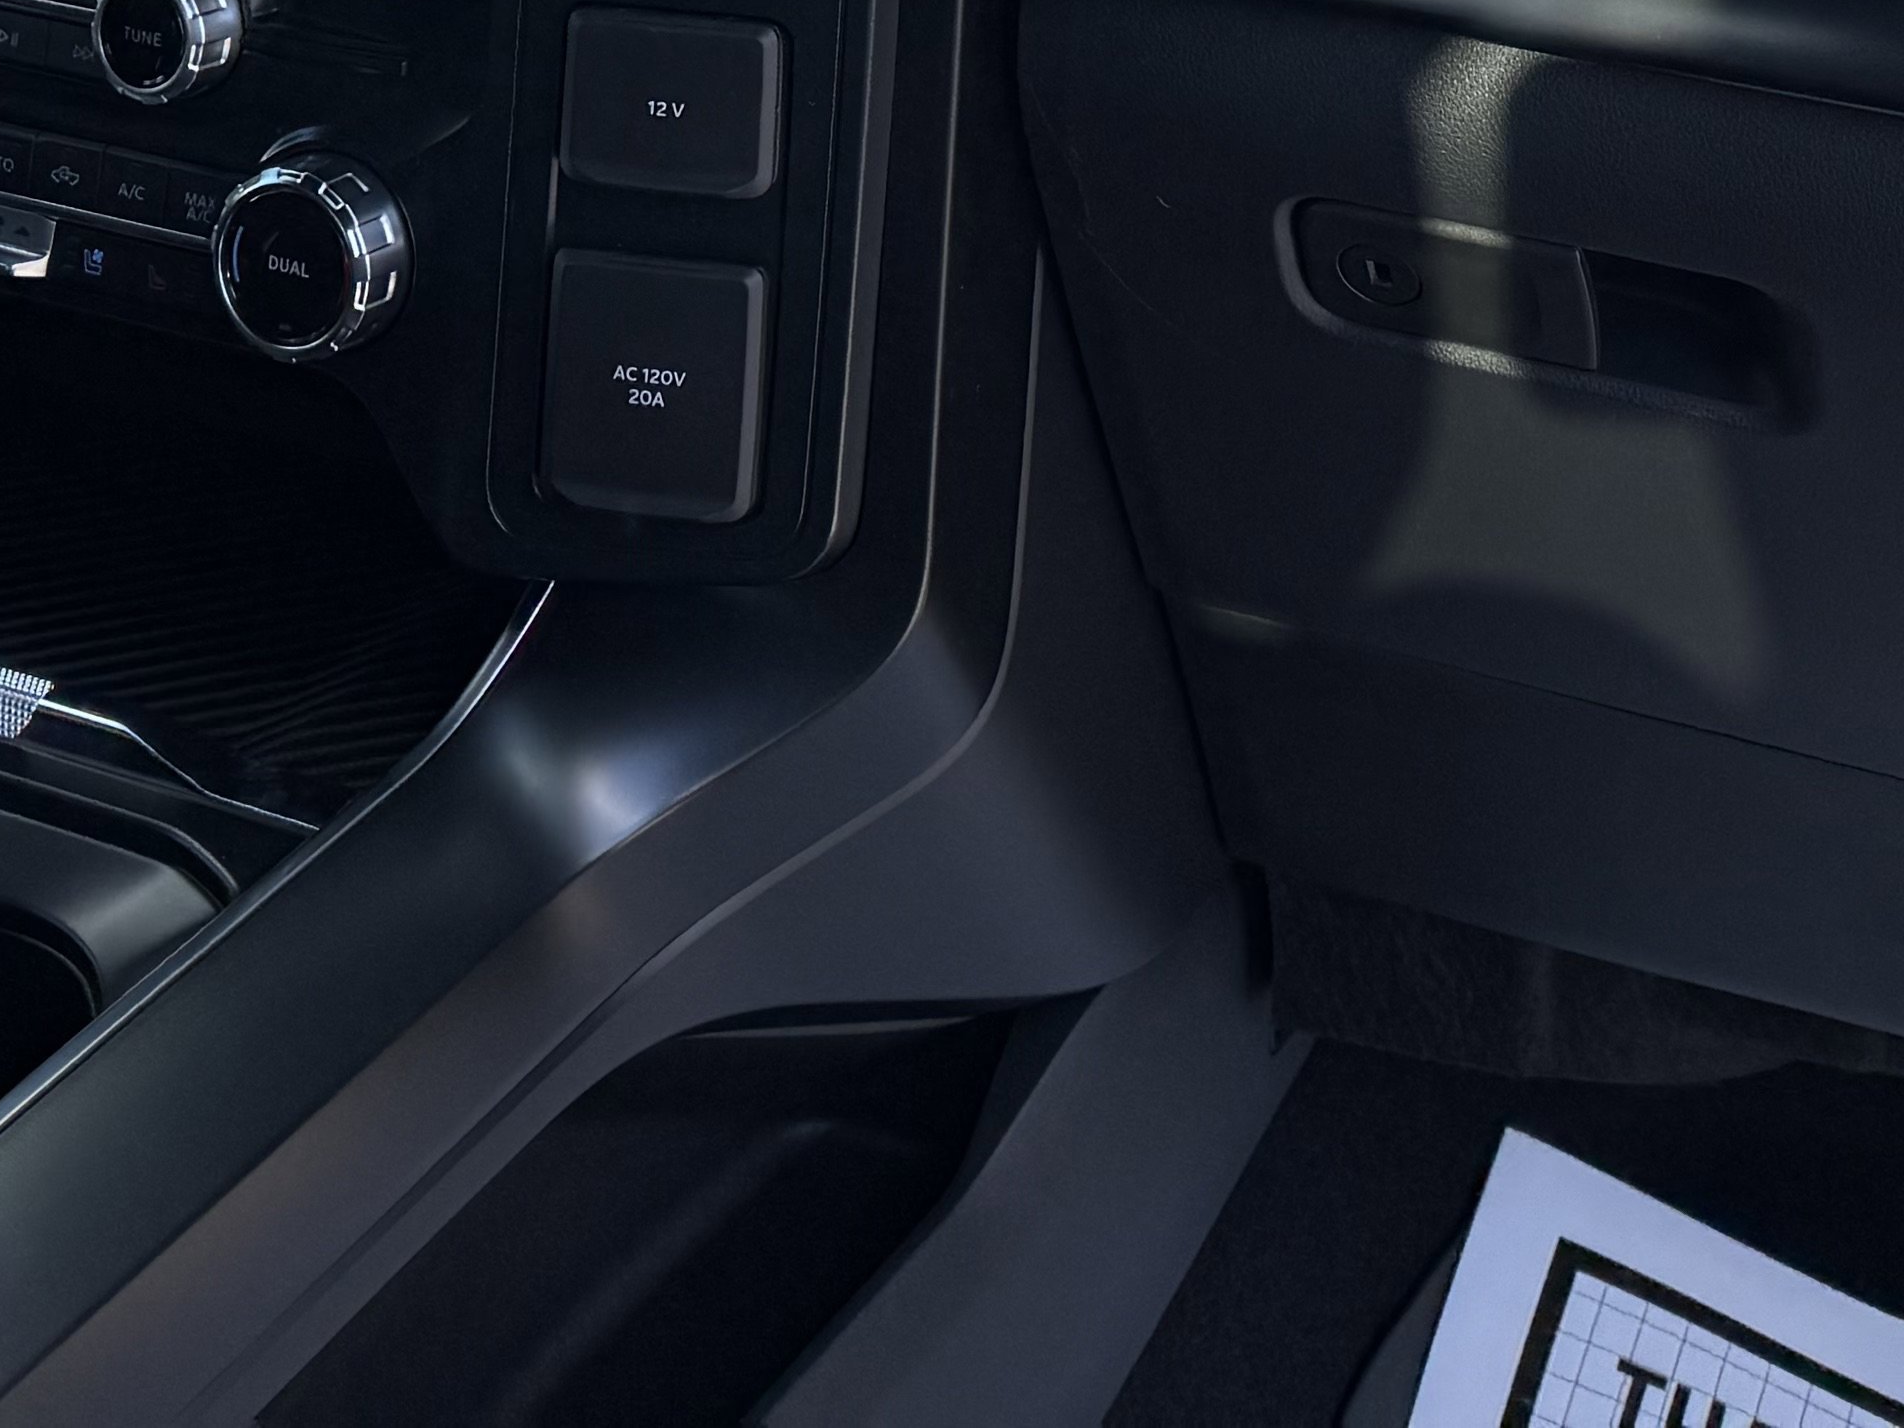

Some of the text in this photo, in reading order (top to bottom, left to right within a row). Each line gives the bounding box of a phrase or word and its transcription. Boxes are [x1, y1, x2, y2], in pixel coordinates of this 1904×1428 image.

[123, 24, 162, 48] TUNE
[648, 100, 686, 119] 12 V
[118, 182, 146, 202] A/C
[184, 191, 216, 211] MAX
[268, 254, 310, 280] DUAL
[612, 364, 687, 388] AC 120V
[628, 388, 665, 408] 20A
